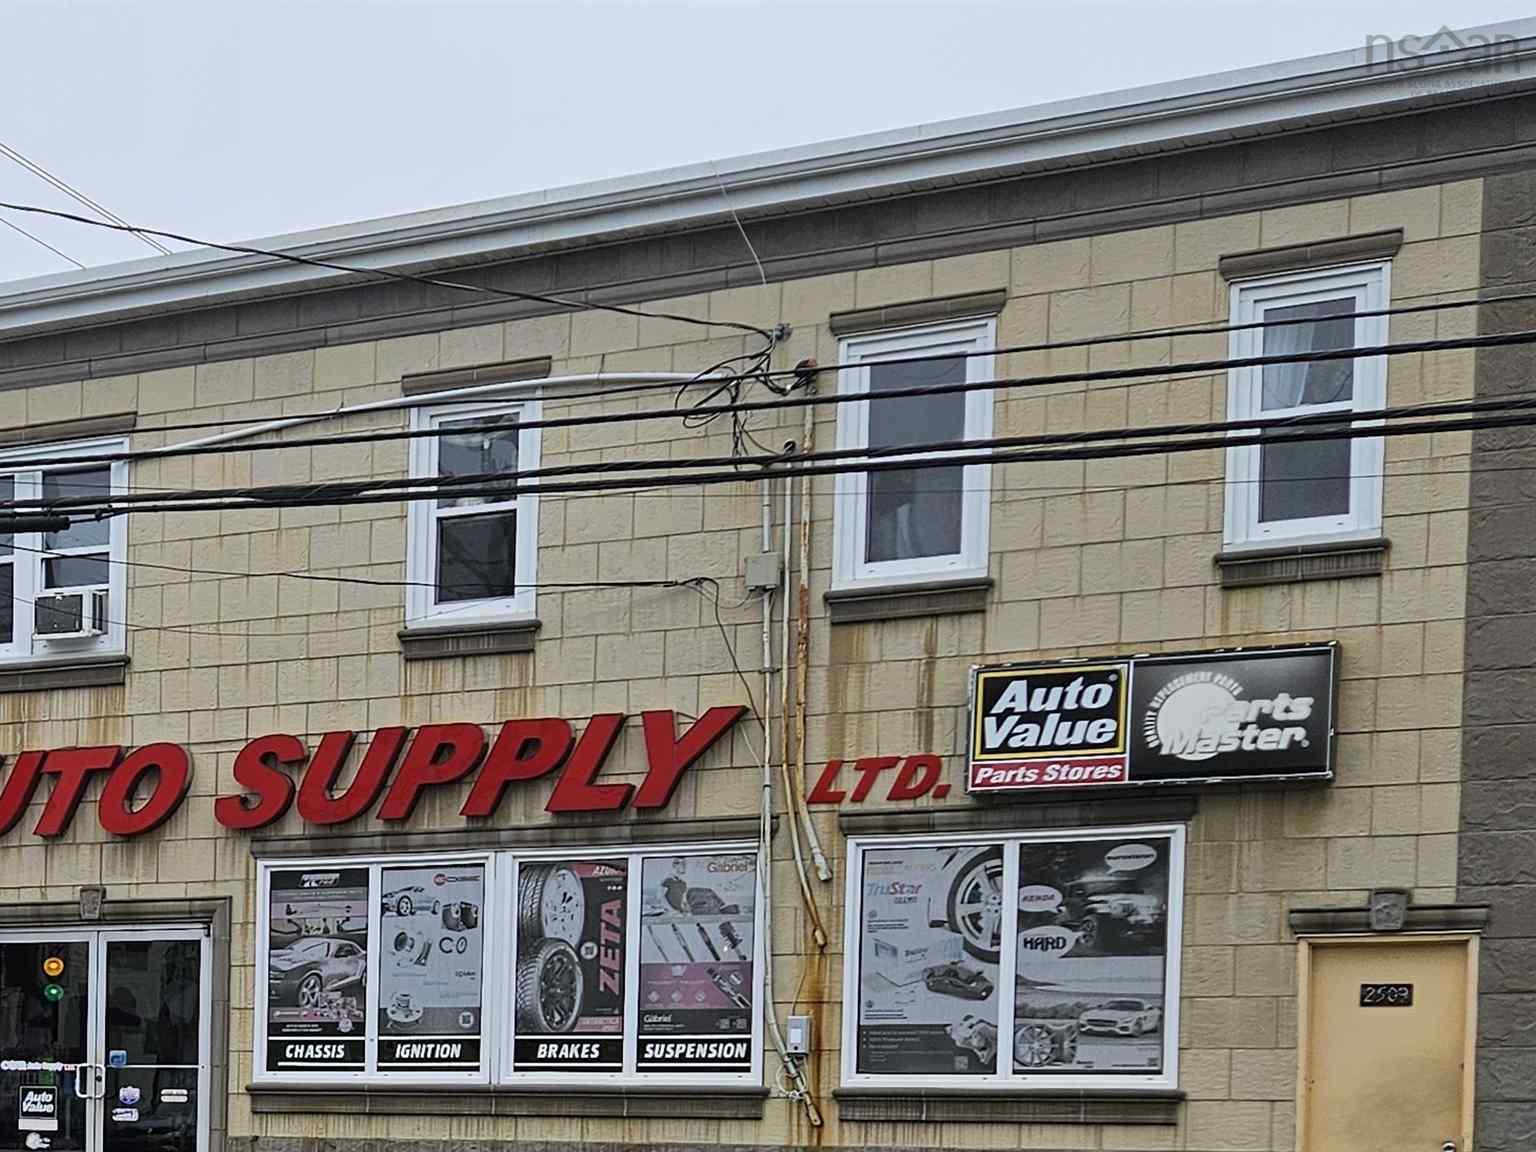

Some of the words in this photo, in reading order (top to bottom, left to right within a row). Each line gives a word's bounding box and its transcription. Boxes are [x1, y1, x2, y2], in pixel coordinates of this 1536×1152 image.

[989, 675, 1114, 714] Auto
[1200, 692, 1315, 726] Parts
[983, 712, 1118, 750] Value
[1159, 722, 1308, 756] Master
[214, 705, 751, 830] SUPPLY
[806, 753, 952, 805] LTD.
[974, 765, 1039, 785] Parts
[1042, 763, 1123, 782] Stores
[599, 899, 624, 996] ZETA
[1023, 936, 1067, 952] HARD
[285, 1044, 345, 1059] CHASSIS
[394, 1043, 462, 1059] IGNITION
[536, 1043, 601, 1059] BRAKES
[643, 1043, 748, 1059] SUSPENSION
[24, 1091, 54, 1103] Auto
